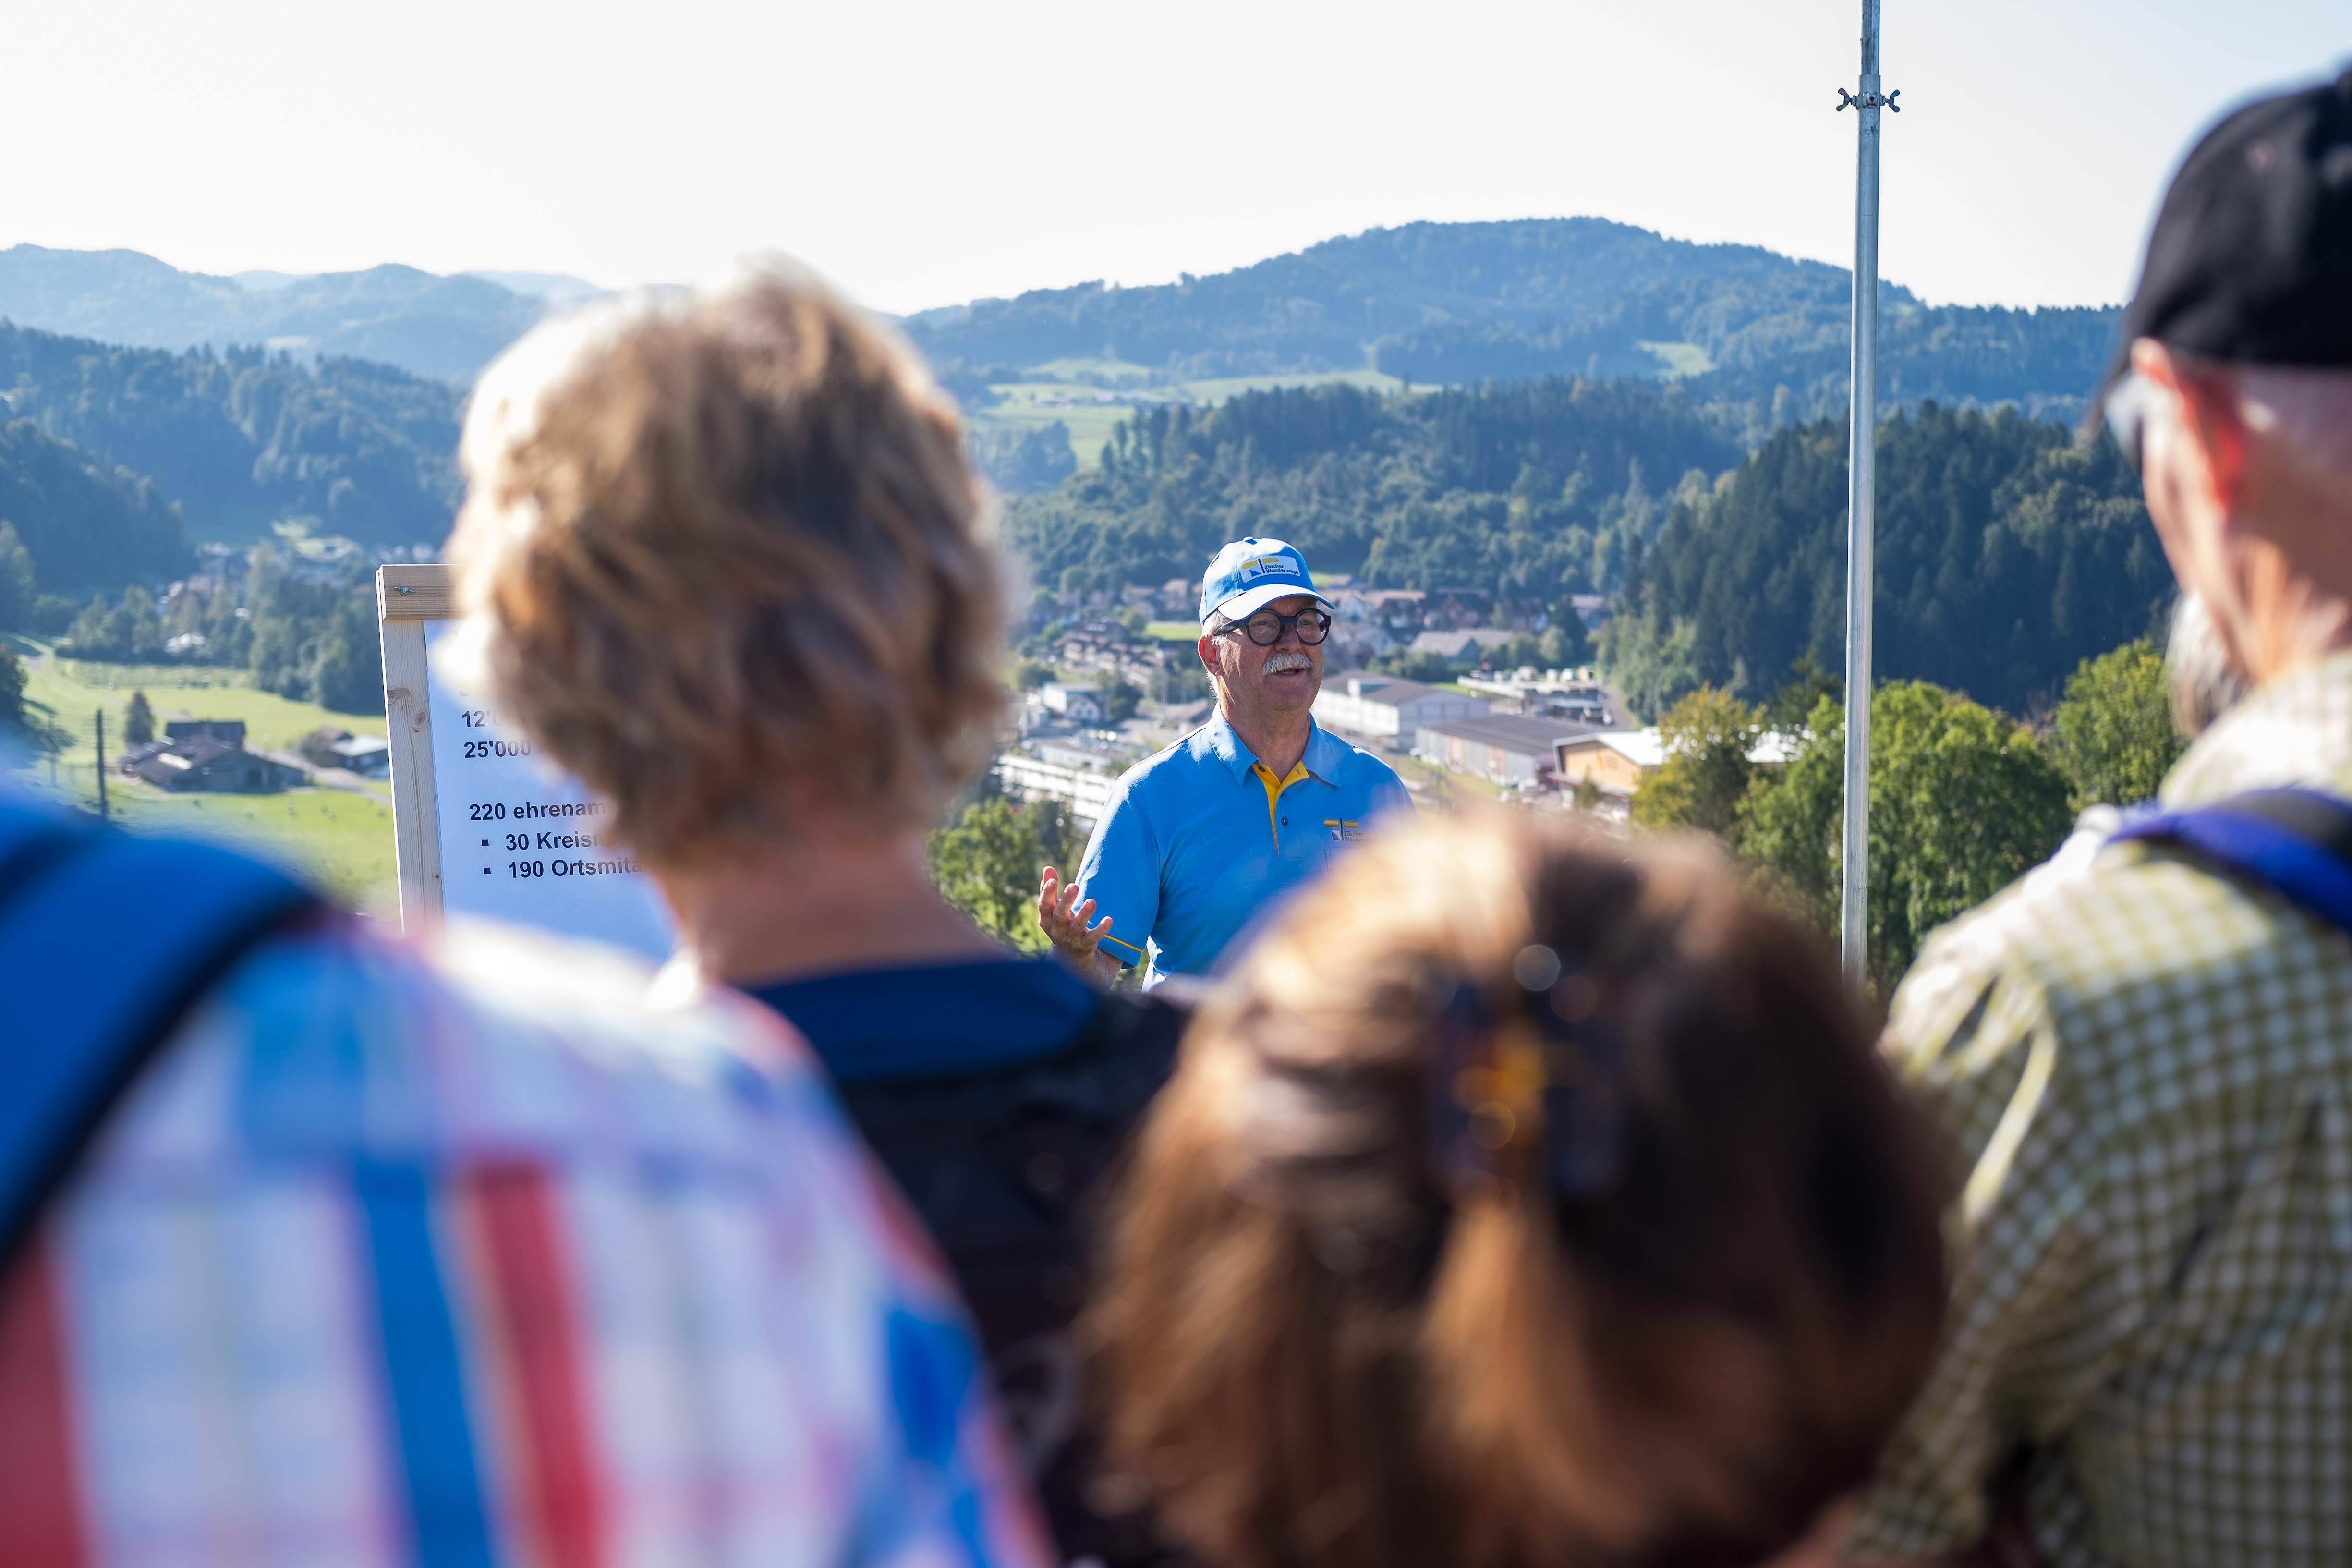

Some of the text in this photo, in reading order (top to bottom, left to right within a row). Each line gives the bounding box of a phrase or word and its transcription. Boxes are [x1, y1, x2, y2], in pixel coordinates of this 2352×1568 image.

[464, 741, 532, 758] 25'000
[469, 803, 506, 820] 220
[505, 834, 529, 851] 30
[508, 861, 544, 878] 190
